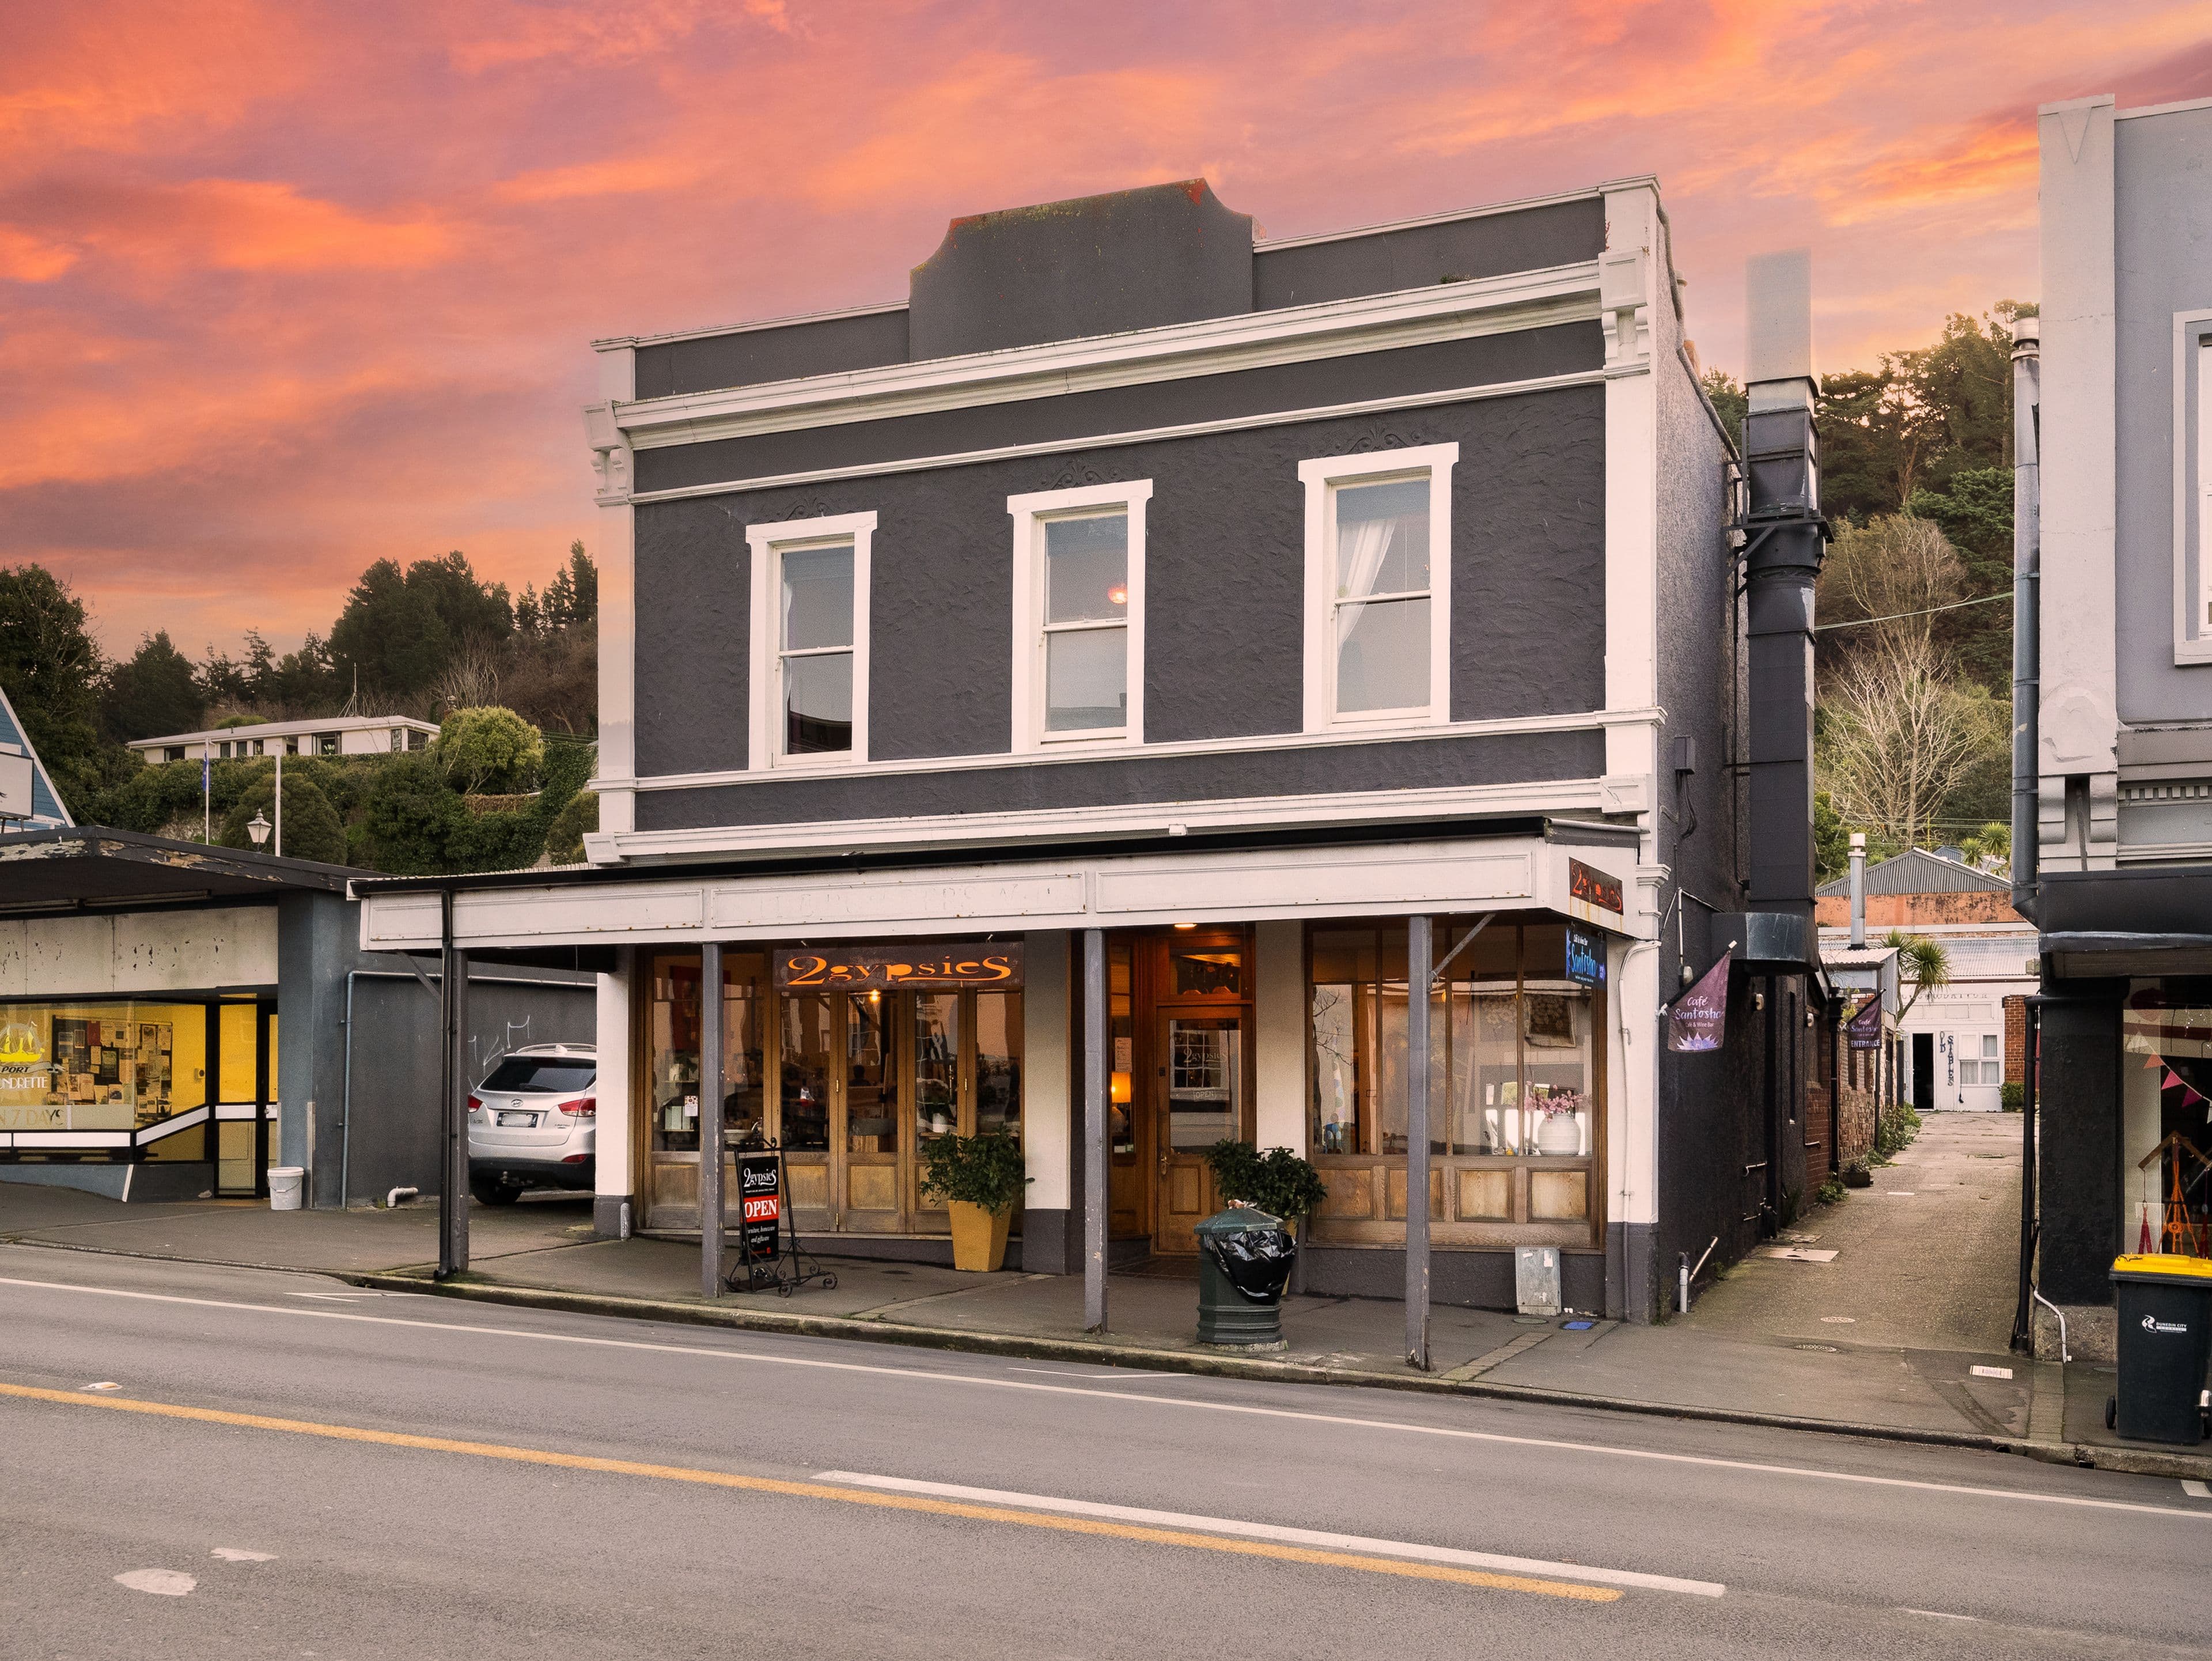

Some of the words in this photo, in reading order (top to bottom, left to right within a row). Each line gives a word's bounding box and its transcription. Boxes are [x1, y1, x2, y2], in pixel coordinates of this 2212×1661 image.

[1687, 996, 1709, 1007] Café
[1851, 1039, 1880, 1047] ENTRANCE
[744, 1200, 778, 1218] OPEN
